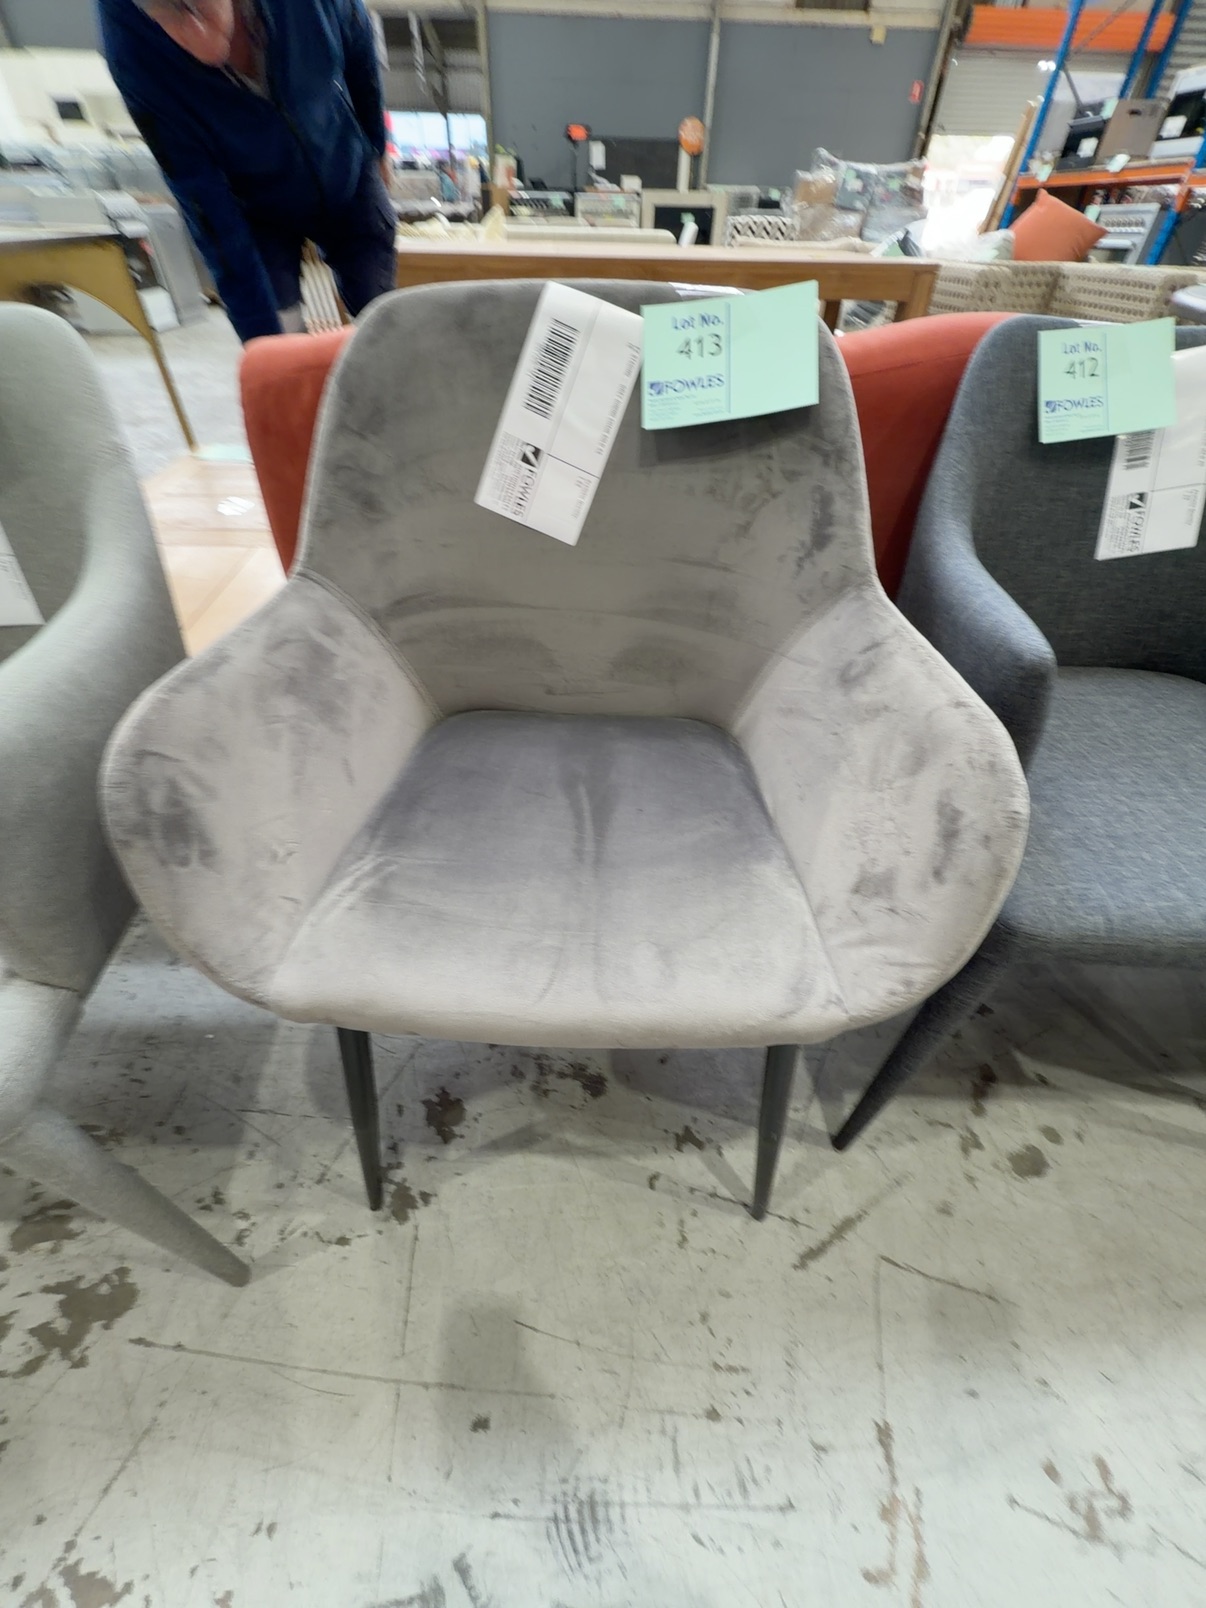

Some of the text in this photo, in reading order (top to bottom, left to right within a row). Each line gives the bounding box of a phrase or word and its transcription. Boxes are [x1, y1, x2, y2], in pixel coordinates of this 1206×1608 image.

[671, 312, 724, 331] Lot No.
[677, 333, 723, 359] 413
[1062, 341, 1103, 355] Lot No.
[1064, 356, 1100, 380] 412
[663, 373, 725, 394] FOWLES
[1056, 395, 1104, 411] FOWLES
[517, 469, 537, 519] FOWLES
[1130, 509, 1146, 553] FOWLES
